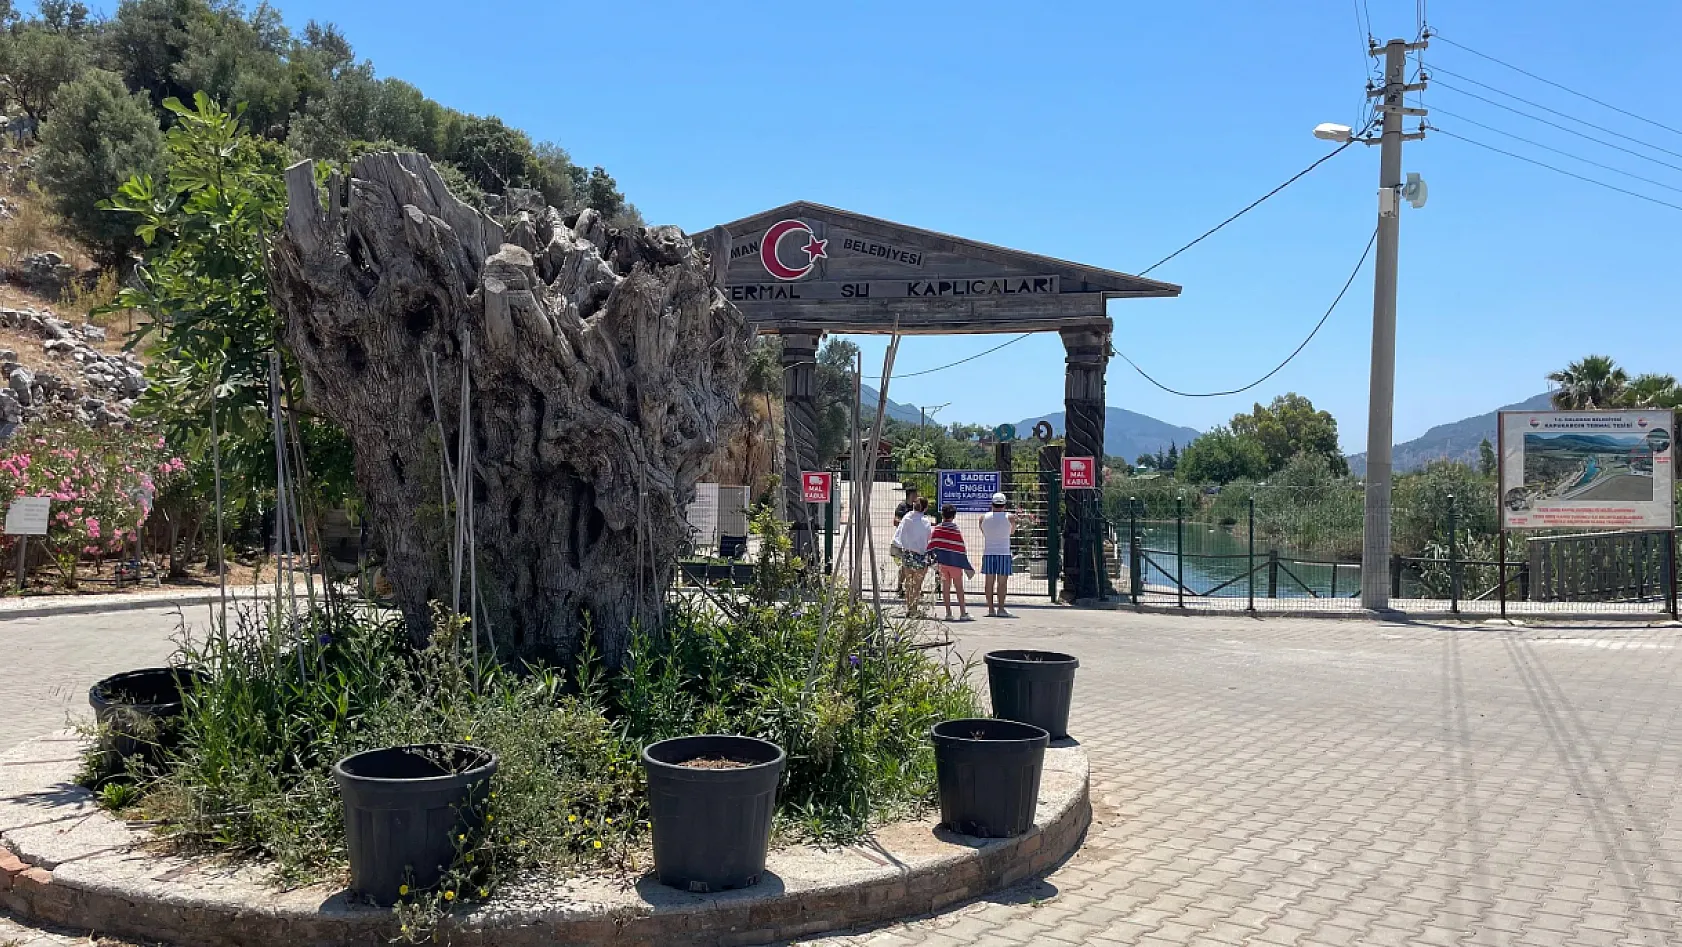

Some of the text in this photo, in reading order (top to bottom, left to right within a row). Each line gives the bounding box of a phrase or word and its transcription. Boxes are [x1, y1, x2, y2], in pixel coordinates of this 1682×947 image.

[843, 238, 922, 266] BELEDİYESİ
[840, 282, 870, 298] SU
[907, 278, 1053, 297] KAPLICALARI
[960, 483, 997, 492] ENGELLİ
